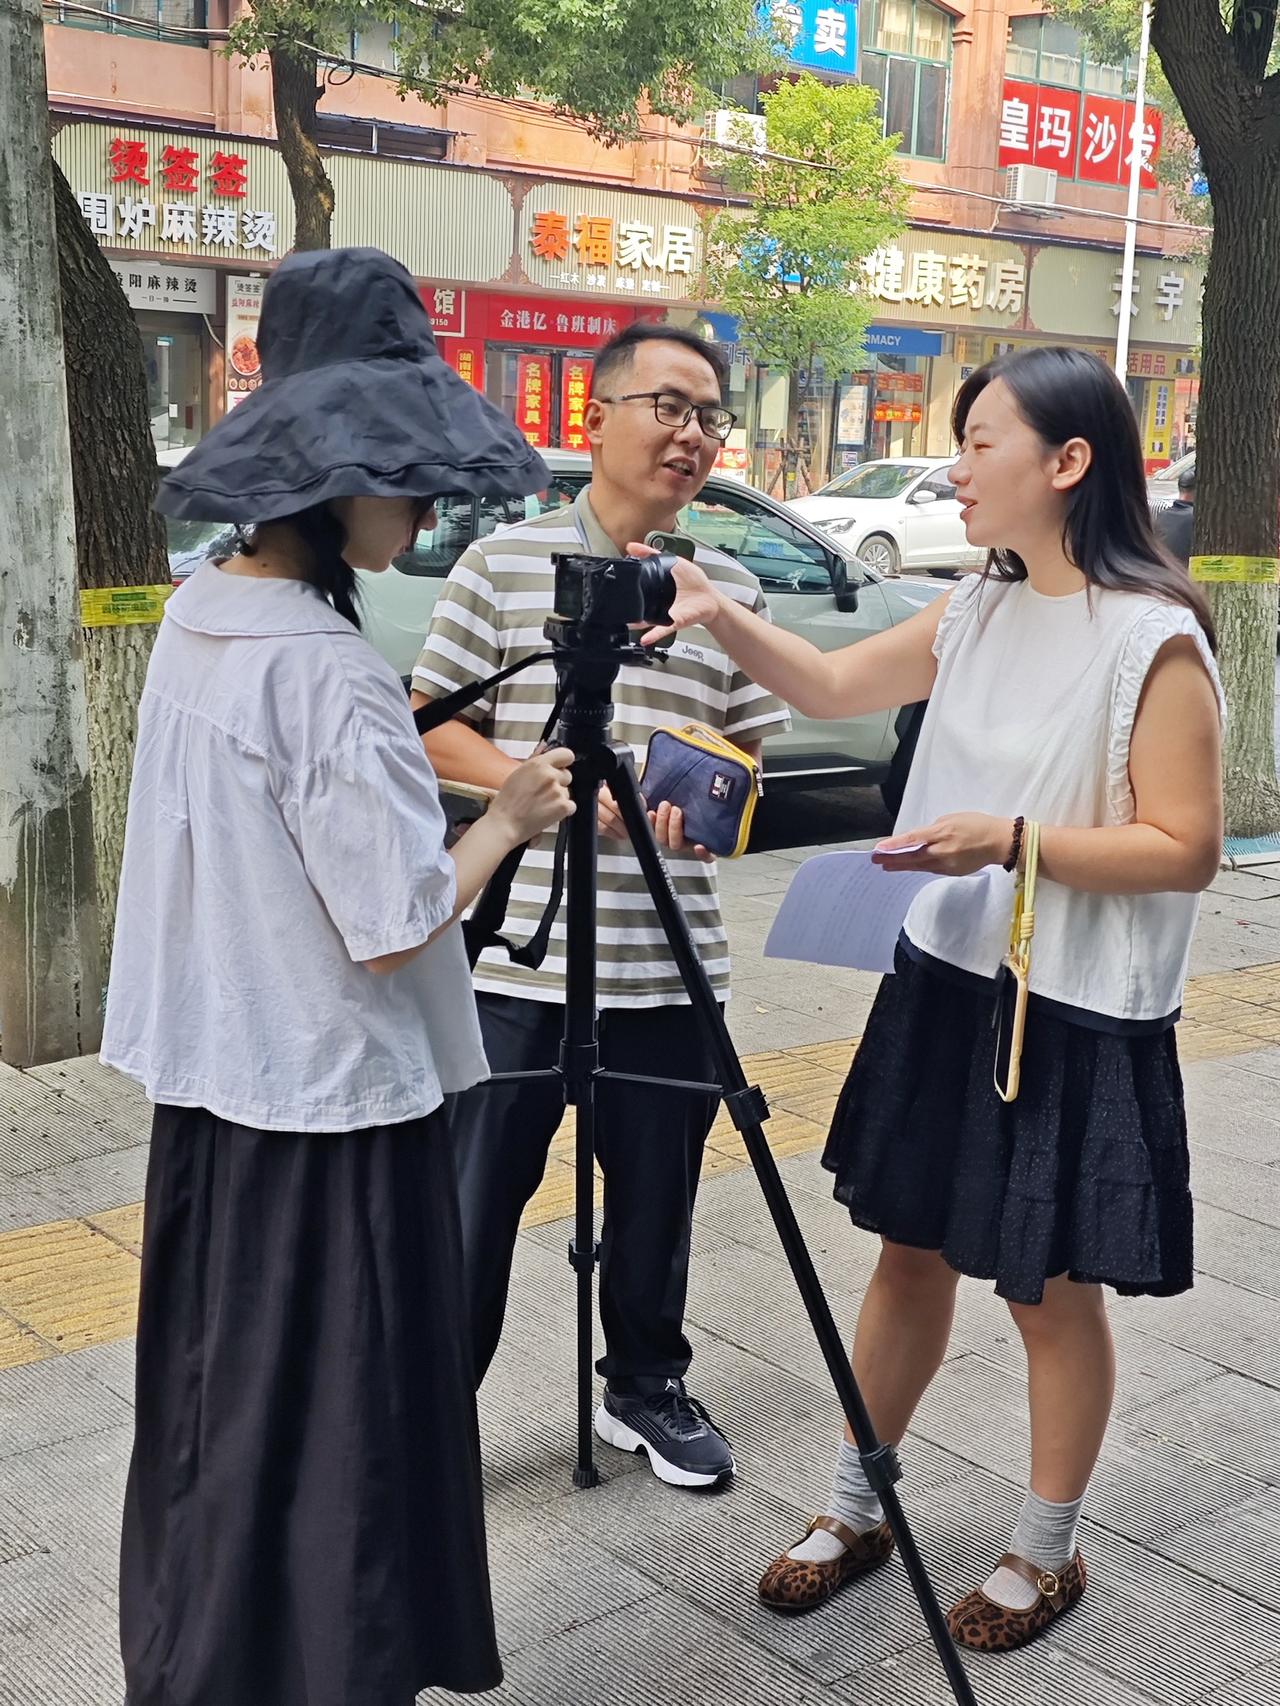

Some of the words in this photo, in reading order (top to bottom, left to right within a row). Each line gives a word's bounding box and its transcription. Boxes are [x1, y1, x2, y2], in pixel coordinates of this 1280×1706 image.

[999, 97, 1156, 173] 皇玛沙发
[109, 137, 248, 199] 烫签签
[77, 191, 277, 252] 围炉麻辣烫
[530, 210, 695, 274] 泰福家居
[433, 287, 456, 315] 馆
[862, 246, 1025, 314] 健康药房
[524, 362, 542, 425] 名牌家具
[567, 365, 585, 428] 名牌家具
